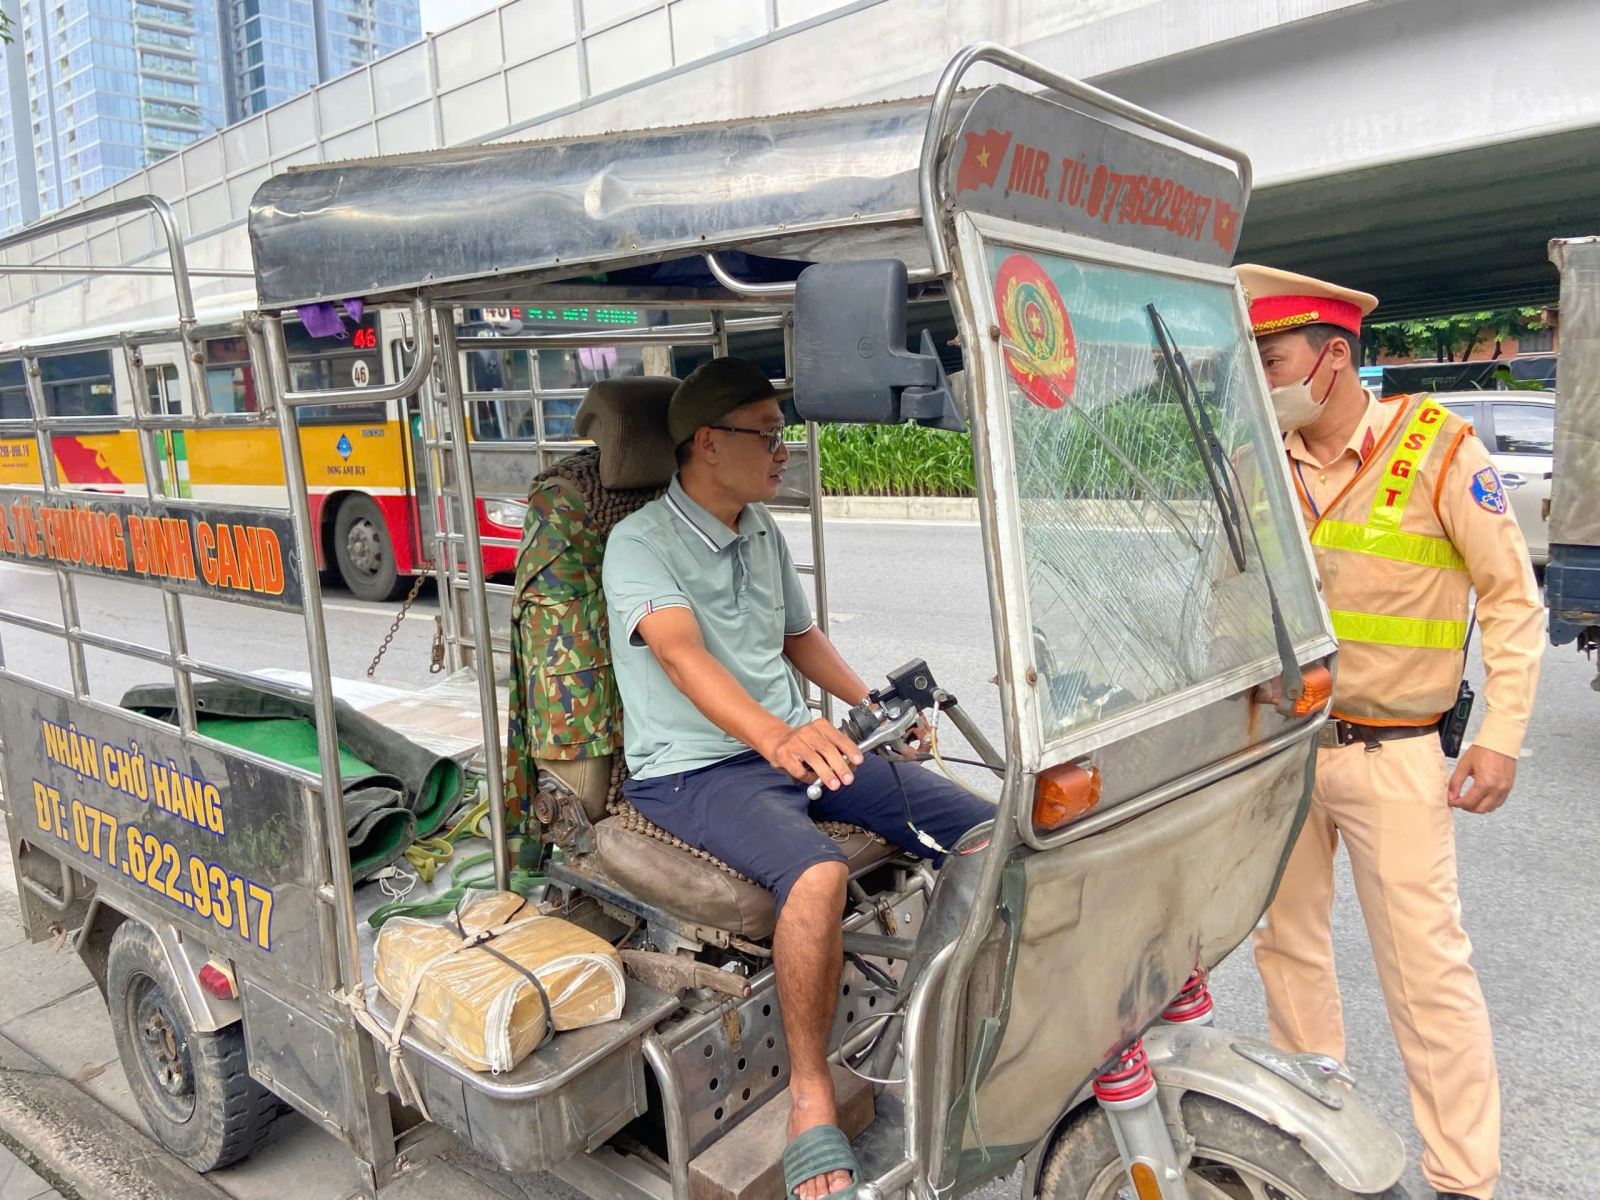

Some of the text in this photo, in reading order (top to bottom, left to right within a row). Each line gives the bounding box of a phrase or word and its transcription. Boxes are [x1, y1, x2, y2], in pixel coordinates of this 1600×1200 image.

[1008, 143, 1050, 199] MR.
[353, 327, 376, 349] 46
[354, 367, 367, 384] 46
[1384, 407, 1441, 508] CSGT
[127, 514, 197, 582] BINH
[198, 521, 285, 596] CAND
[42, 719, 226, 838] NHẬN CHỞ HÀNG
[32, 777, 275, 952] ĐT: 077.622.9317
